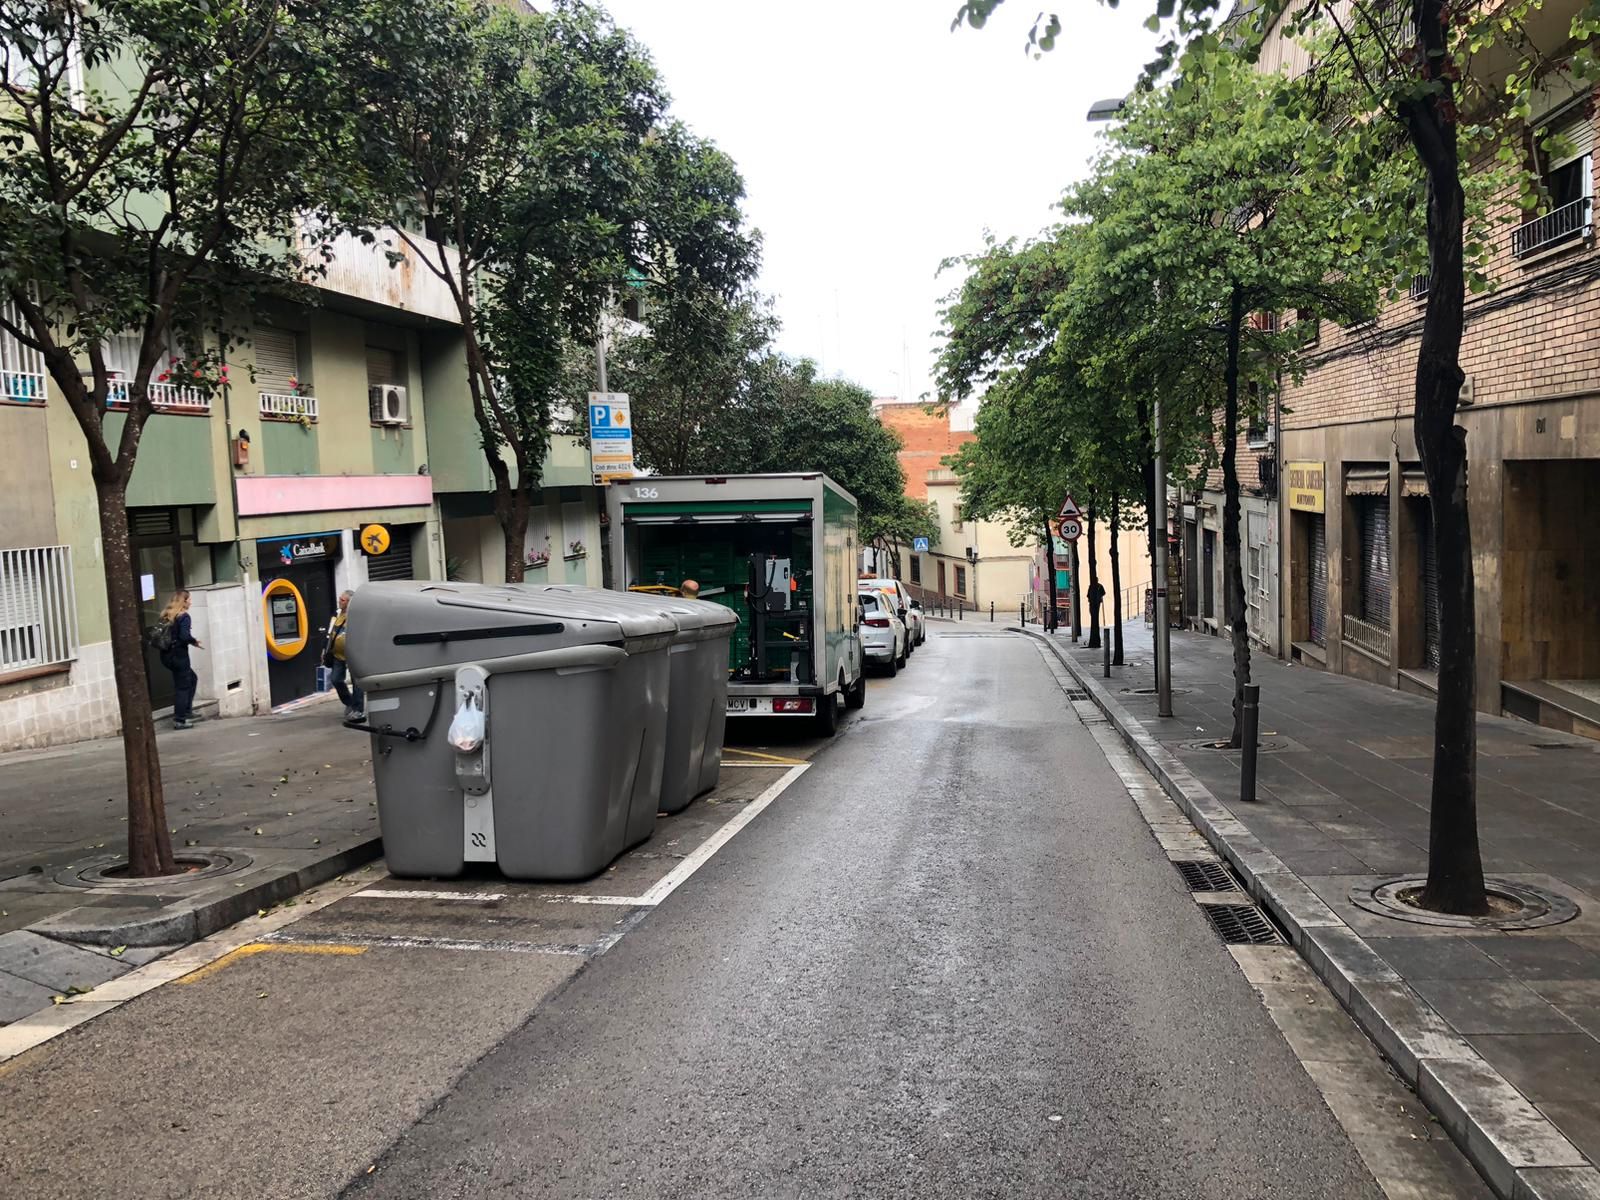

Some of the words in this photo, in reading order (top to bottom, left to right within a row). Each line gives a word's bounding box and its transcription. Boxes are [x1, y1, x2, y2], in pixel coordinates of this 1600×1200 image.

[634, 487, 658, 499] 136
[1063, 525, 1077, 534] 30
[292, 542, 326, 556] CaixaBank
[727, 699, 745, 709] MCV
